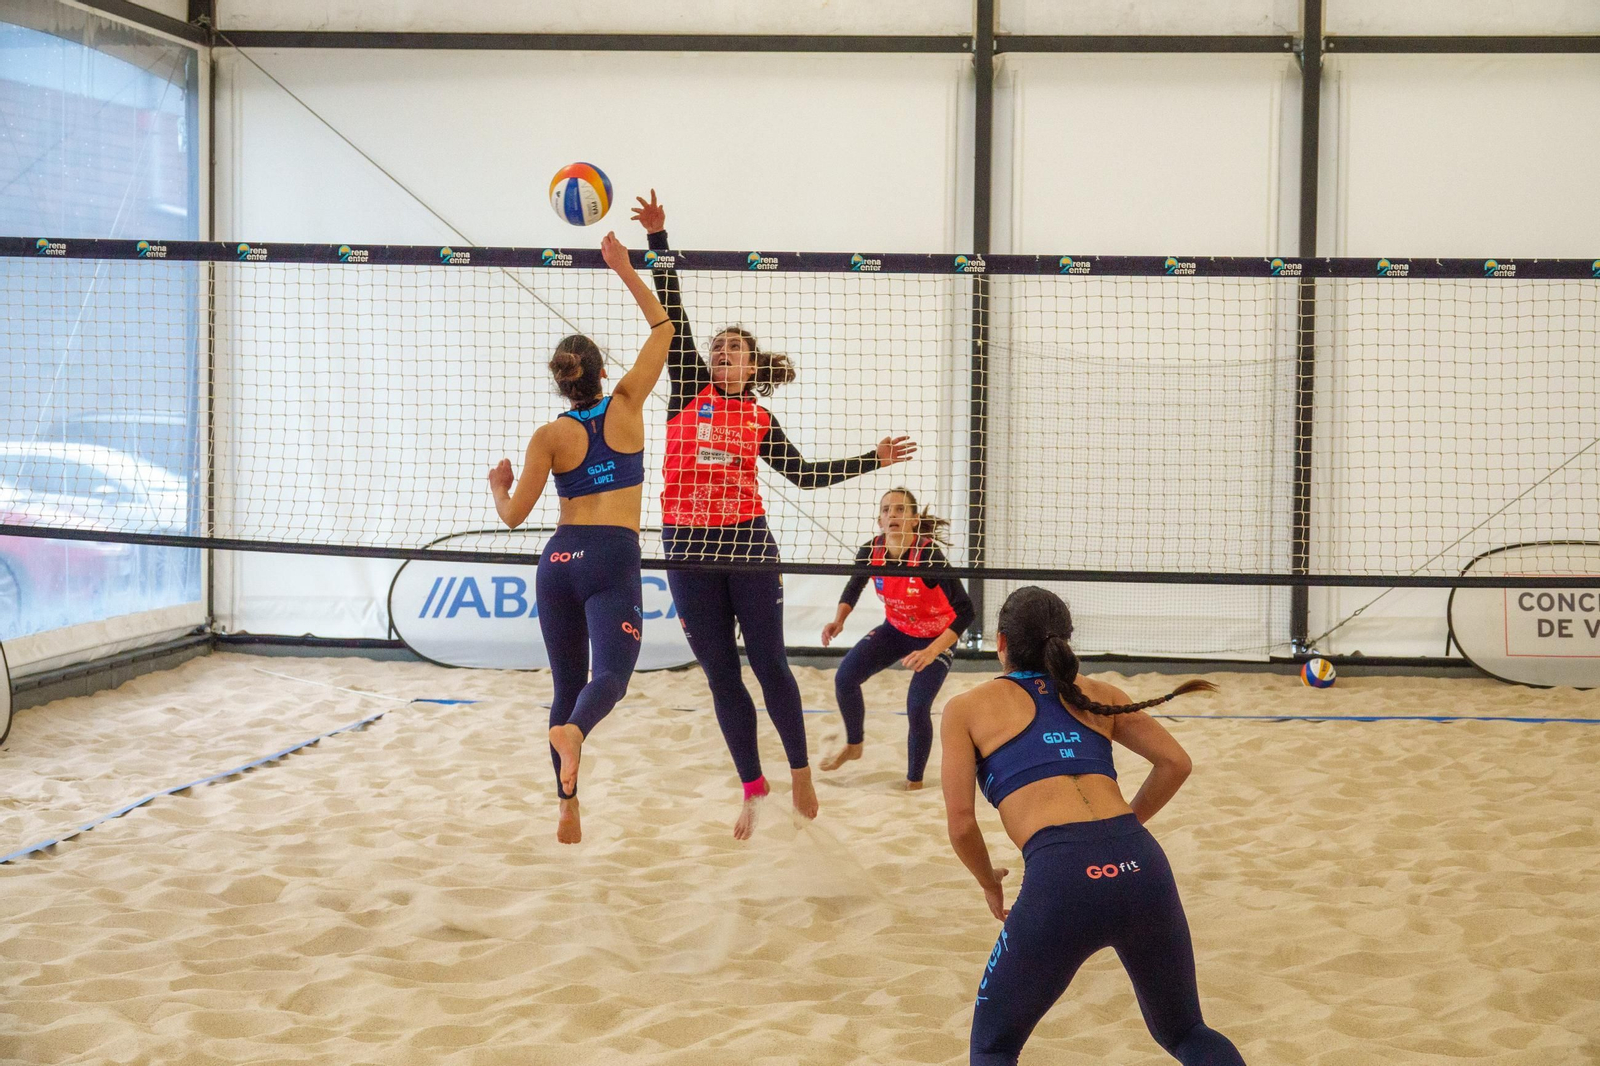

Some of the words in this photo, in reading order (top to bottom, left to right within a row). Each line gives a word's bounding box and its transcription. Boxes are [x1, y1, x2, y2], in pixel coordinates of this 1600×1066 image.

[594, 474, 614, 485] LOPEZ
[1518, 592, 1600, 612] CONC
[1537, 618, 1574, 638] DE
[1034, 679, 1049, 695] 2
[1043, 732, 1082, 744] GDLR
[1059, 749, 1075, 758] EMI
